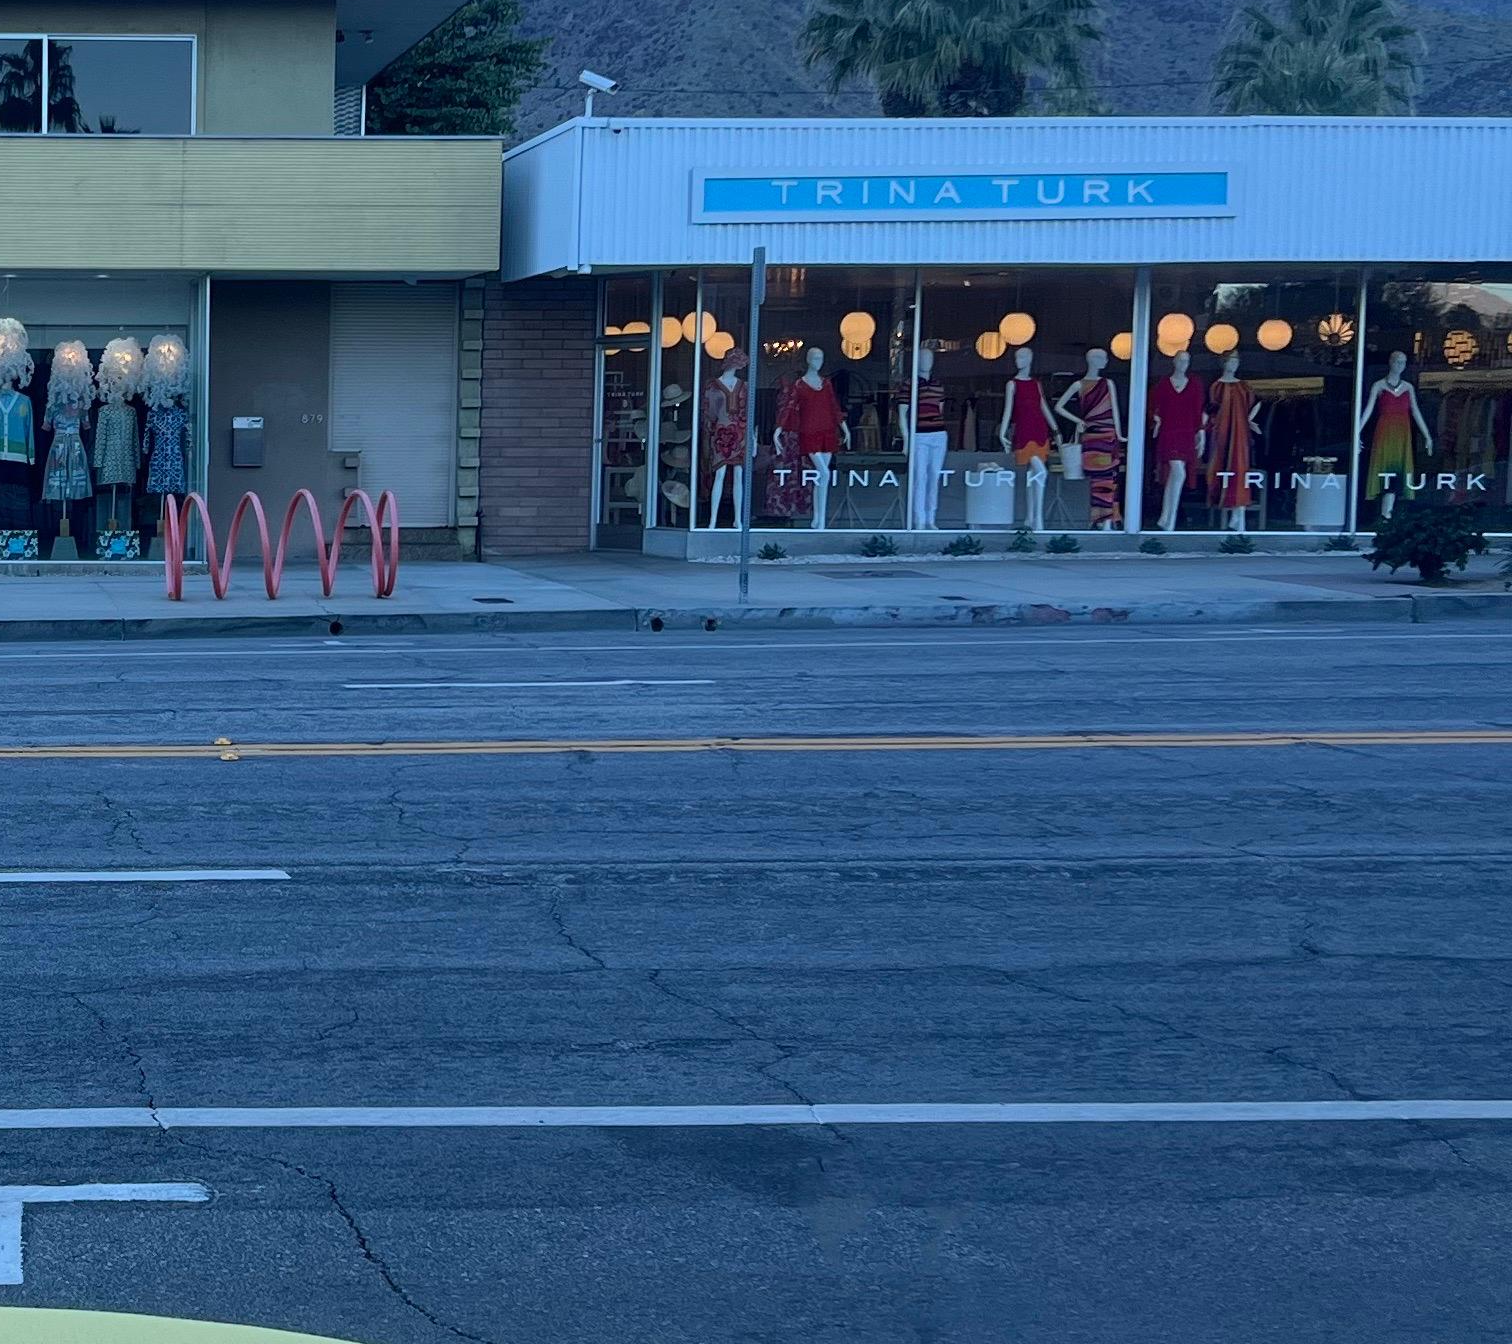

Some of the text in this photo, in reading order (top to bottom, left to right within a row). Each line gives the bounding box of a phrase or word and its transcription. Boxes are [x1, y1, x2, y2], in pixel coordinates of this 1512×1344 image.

[770, 179, 1156, 205] TRINA TURK
[301, 414, 323, 424] 879
[773, 469, 1046, 488] TRINA TURK
[1216, 471, 1487, 491] TRINA TURK
